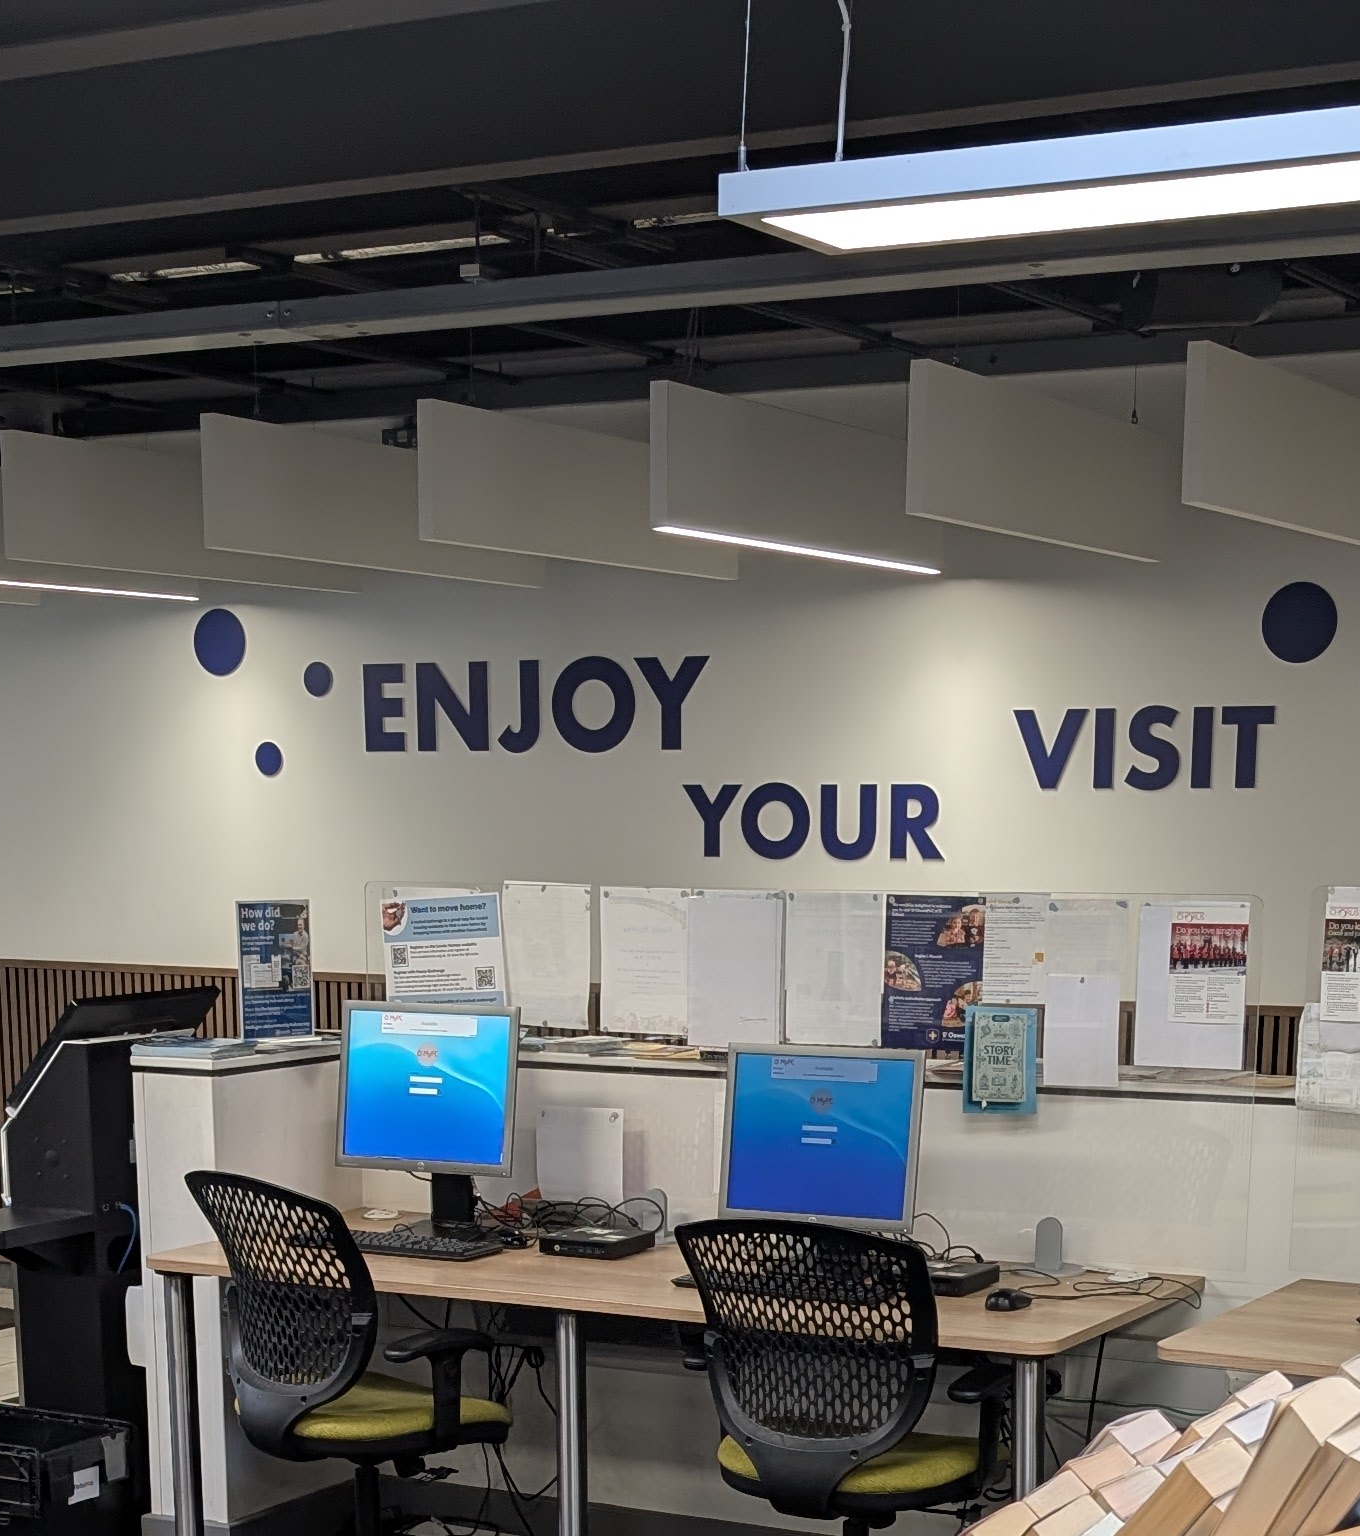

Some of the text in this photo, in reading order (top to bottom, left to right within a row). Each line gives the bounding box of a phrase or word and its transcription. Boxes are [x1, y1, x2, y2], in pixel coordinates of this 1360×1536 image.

[362, 655, 710, 754] ENJOY
[1013, 704, 1276, 791] VISIT
[682, 781, 945, 861] YOUR
[240, 906, 281, 919] How did
[410, 905, 429, 914] Want
[429, 905, 437, 913] to
[459, 902, 487, 911] home?
[241, 919, 275, 931] we do?
[1328, 921, 1340, 931] Do
[1341, 922, 1355, 933] you
[1176, 925, 1246, 938] Do you love singing?
[983, 1045, 1016, 1056] STORY
[986, 1055, 1012, 1066] TIME
